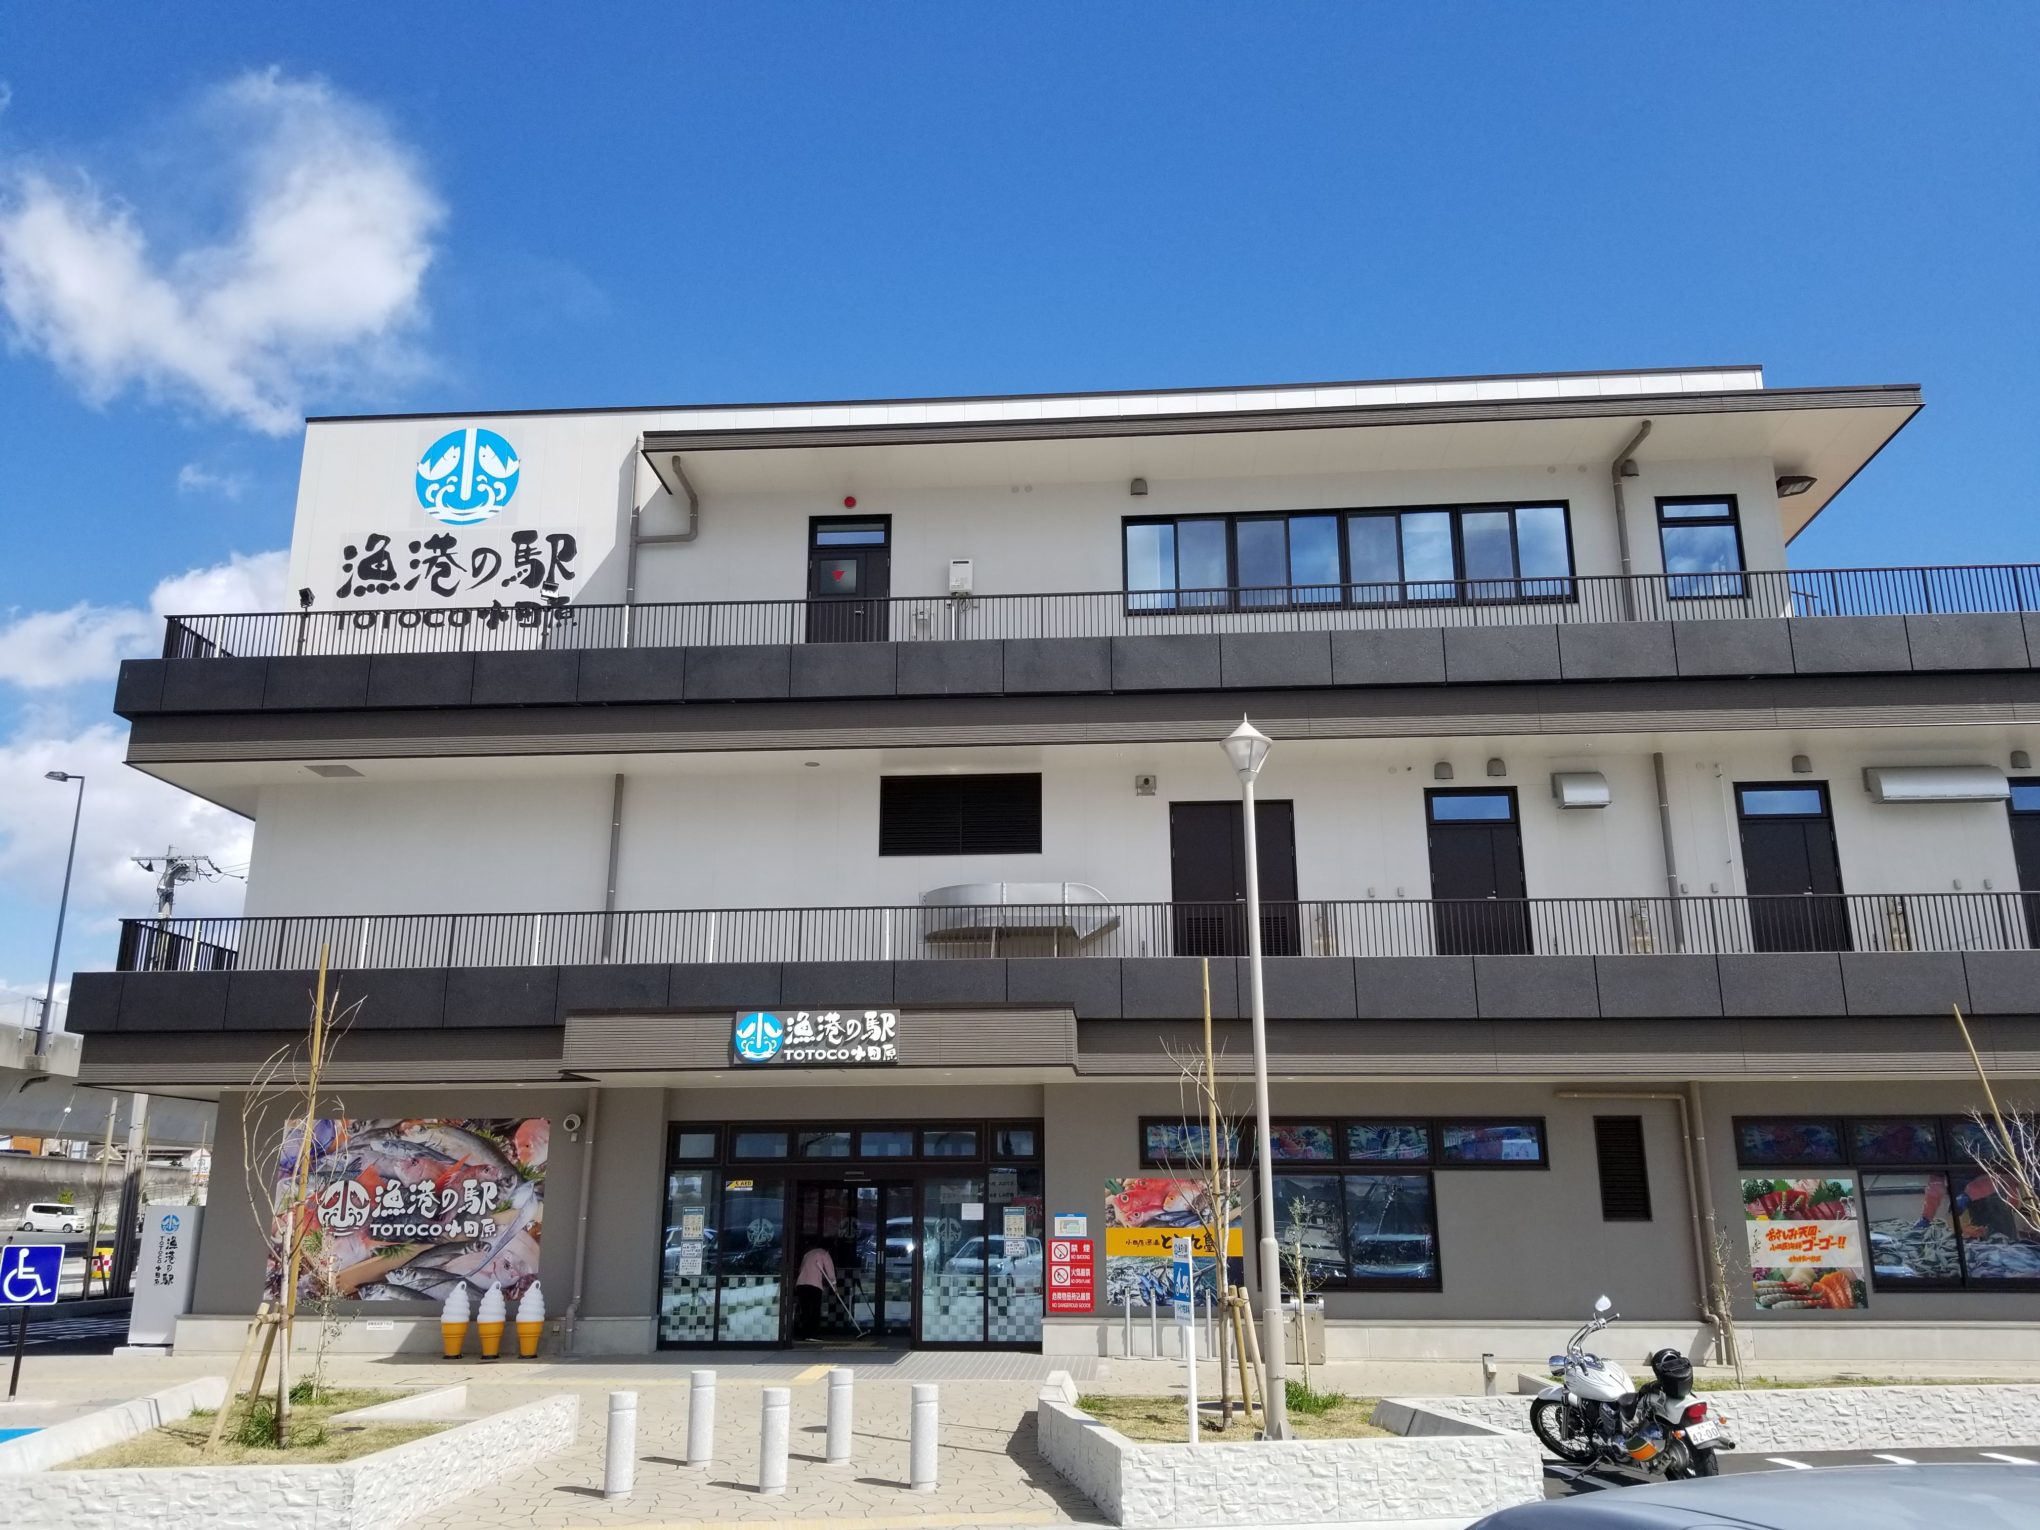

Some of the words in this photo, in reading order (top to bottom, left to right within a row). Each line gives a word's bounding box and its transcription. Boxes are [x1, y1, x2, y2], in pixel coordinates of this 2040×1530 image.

[337, 530, 577, 598] 漁港の駅
[784, 1011, 896, 1045] 漁港の駅
[372, 1179, 498, 1219] 漁港の駅
[160, 1235, 178, 1286] 漁港の駅
